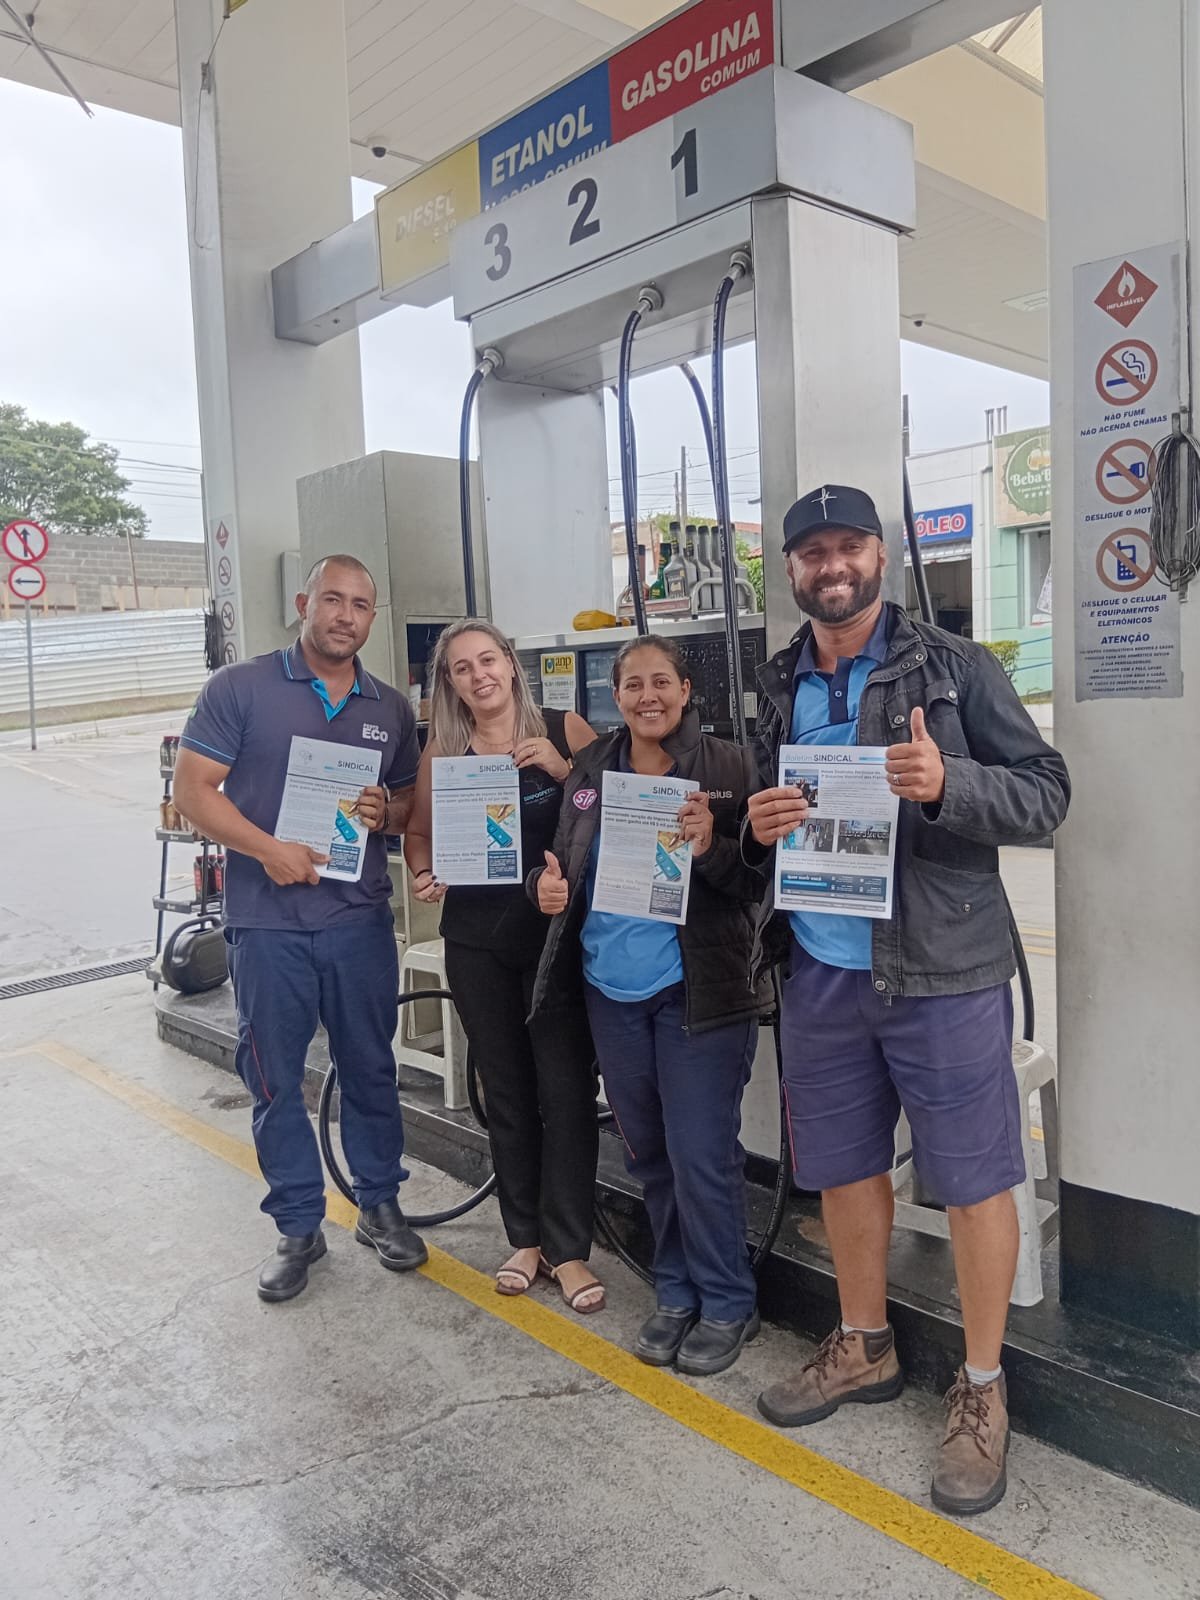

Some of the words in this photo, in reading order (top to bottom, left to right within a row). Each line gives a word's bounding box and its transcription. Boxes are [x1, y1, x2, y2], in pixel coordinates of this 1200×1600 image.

[621, 11, 761, 112] GASOLINA
[700, 48, 761, 93] COMUM
[491, 103, 594, 188] ETANOL
[671, 127, 698, 198] 1
[567, 177, 601, 246] 2
[484, 223, 512, 281] 3
[1123, 407, 1147, 418] FUME
[1099, 421, 1131, 433] ACENDA
[1133, 414, 1168, 427] CHAMAS
[1010, 471, 1042, 487] Beba
[1085, 511, 1124, 522] DESLIGUE
[1134, 506, 1152, 515] MOT
[914, 513, 966, 538] ÓLEO
[1081, 598, 1120, 608] DESLIGUE
[1130, 594, 1168, 604] CELULAR
[1097, 605, 1160, 617] EQUIPAMENTOS
[1097, 616, 1153, 627] ELETRÔNICOS
[1101, 631, 1151, 645] ATENÇÃO
[555, 656, 572, 669] anp
[362, 728, 389, 743] ECO
[813, 753, 853, 762] SINDICAL
[337, 760, 375, 773] SINDICAL
[479, 763, 514, 773] SINDICAL
[652, 786, 683, 797] SINDIC
